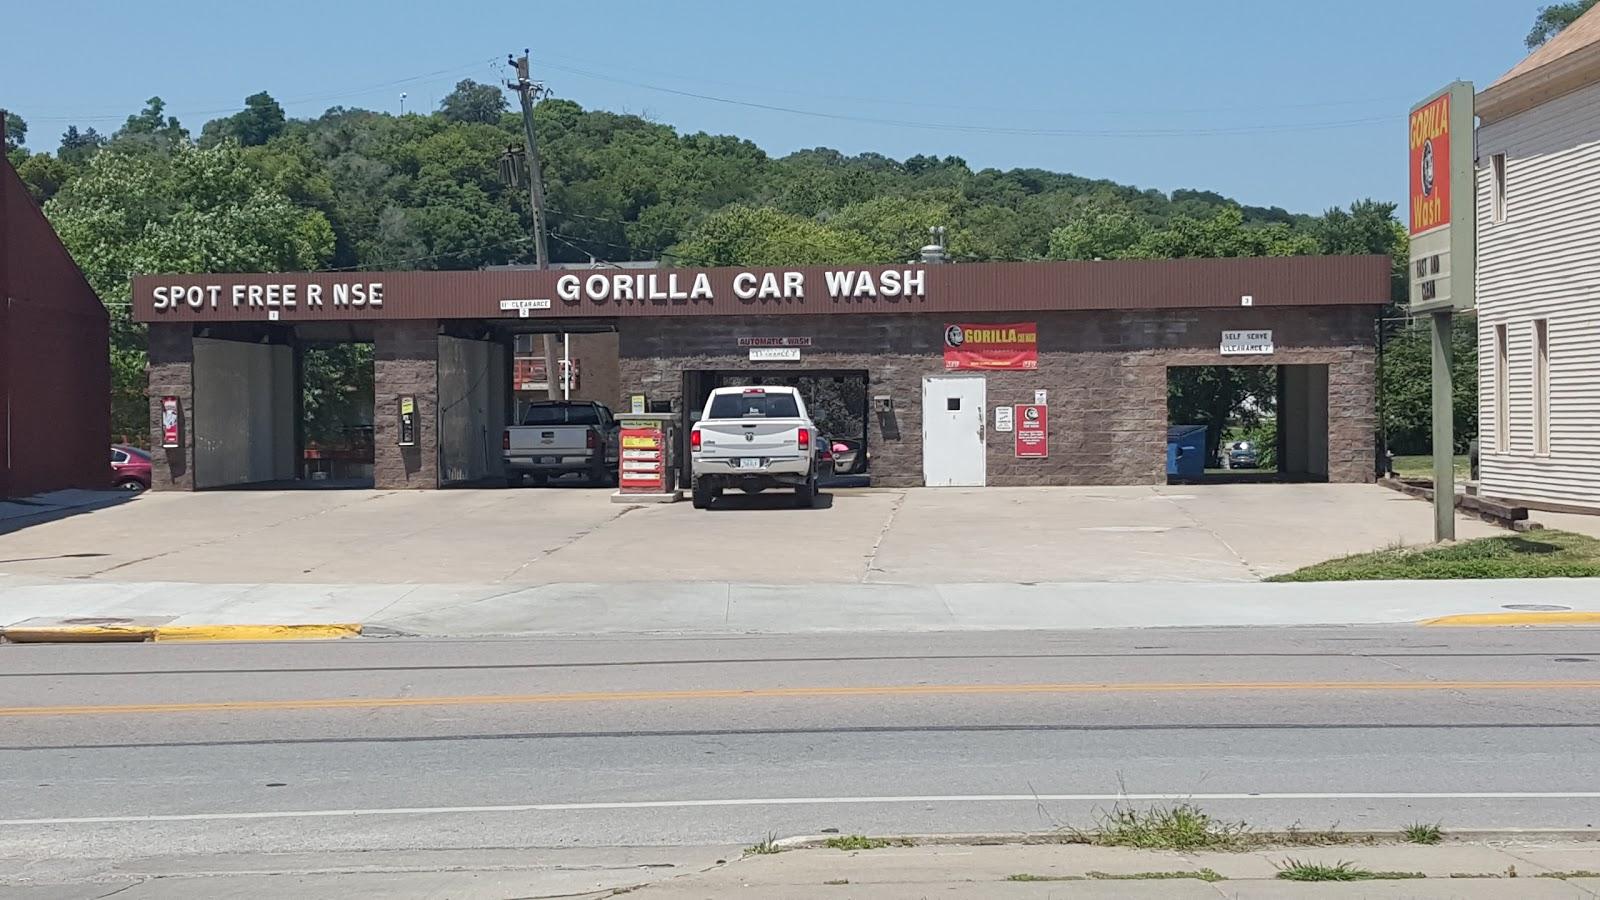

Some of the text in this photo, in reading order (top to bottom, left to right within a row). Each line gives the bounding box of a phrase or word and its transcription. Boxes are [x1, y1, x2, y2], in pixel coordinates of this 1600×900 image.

[1410, 98, 1448, 150] GORILLA
[1413, 186, 1441, 230] Wash
[152, 285, 222, 308] SPOT
[232, 284, 297, 306] FREE
[556, 270, 925, 301] GORILLA CAR WASH
[739, 337, 809, 346] AUTOMATIC WASH
[964, 328, 1017, 343] GORILLA
[1223, 344, 1263, 352] CLEARANCE
